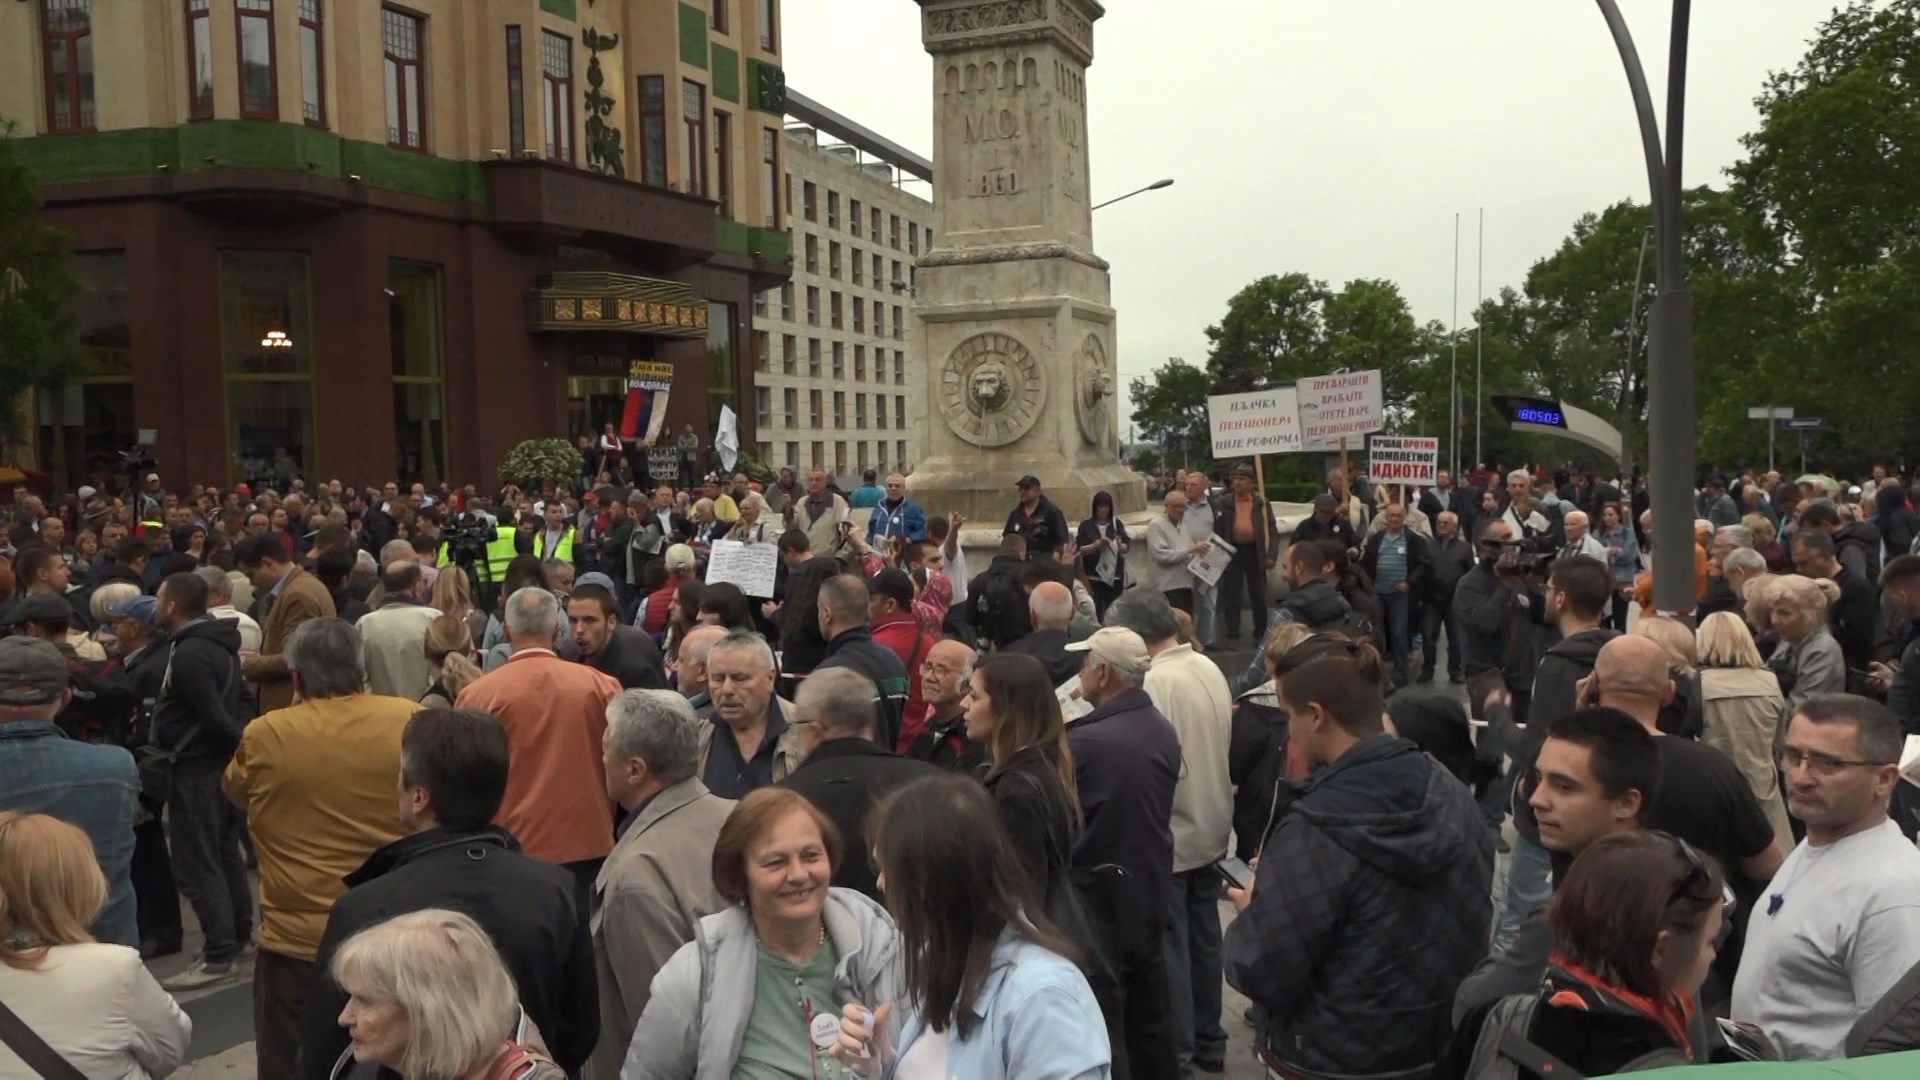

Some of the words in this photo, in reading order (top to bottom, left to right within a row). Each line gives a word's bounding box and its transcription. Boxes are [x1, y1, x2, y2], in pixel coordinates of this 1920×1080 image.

[1230, 399, 1276, 412] ПЉАЧКА
[1219, 416, 1291, 432] ПЕНЗИОНЕРА
[1215, 439, 1244, 450] НИЈЕ
[1246, 434, 1299, 447] РЕФОРМА
[1372, 438, 1402, 449] ВРШАЦ
[1403, 439, 1435, 449] ПРОТИВ
[1372, 451, 1435, 462] КОМПЛЕТНОГ
[1372, 463, 1434, 480] ИДИОТА!
